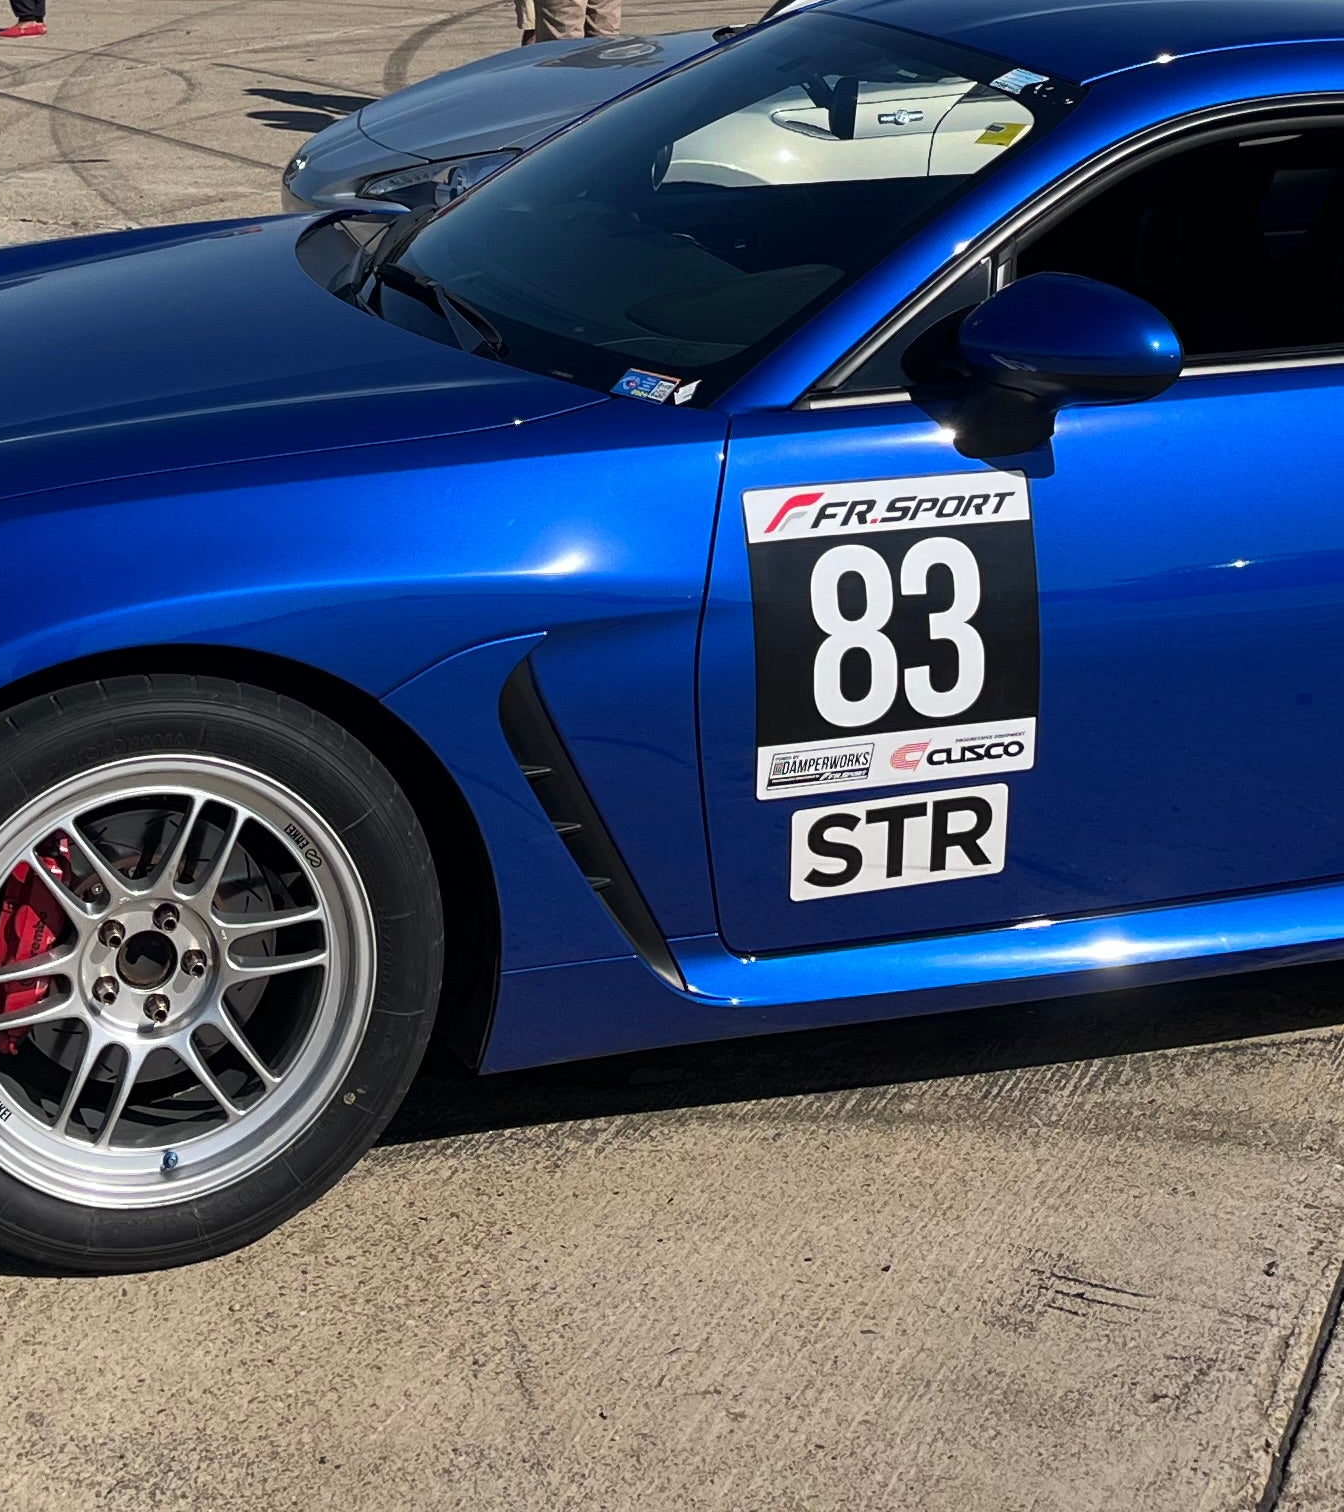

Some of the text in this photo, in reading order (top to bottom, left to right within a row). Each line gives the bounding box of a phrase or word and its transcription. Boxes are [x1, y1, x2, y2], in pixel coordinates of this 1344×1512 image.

[809, 491, 1016, 529] FR.SPORT
[810, 536, 985, 728] 83
[782, 751, 871, 775] DAMPERWORKS
[926, 740, 1025, 766] CUSCO
[283, 823, 310, 849] ENKEI
[803, 794, 993, 888] STR
[30, 911, 48, 956] rembo
